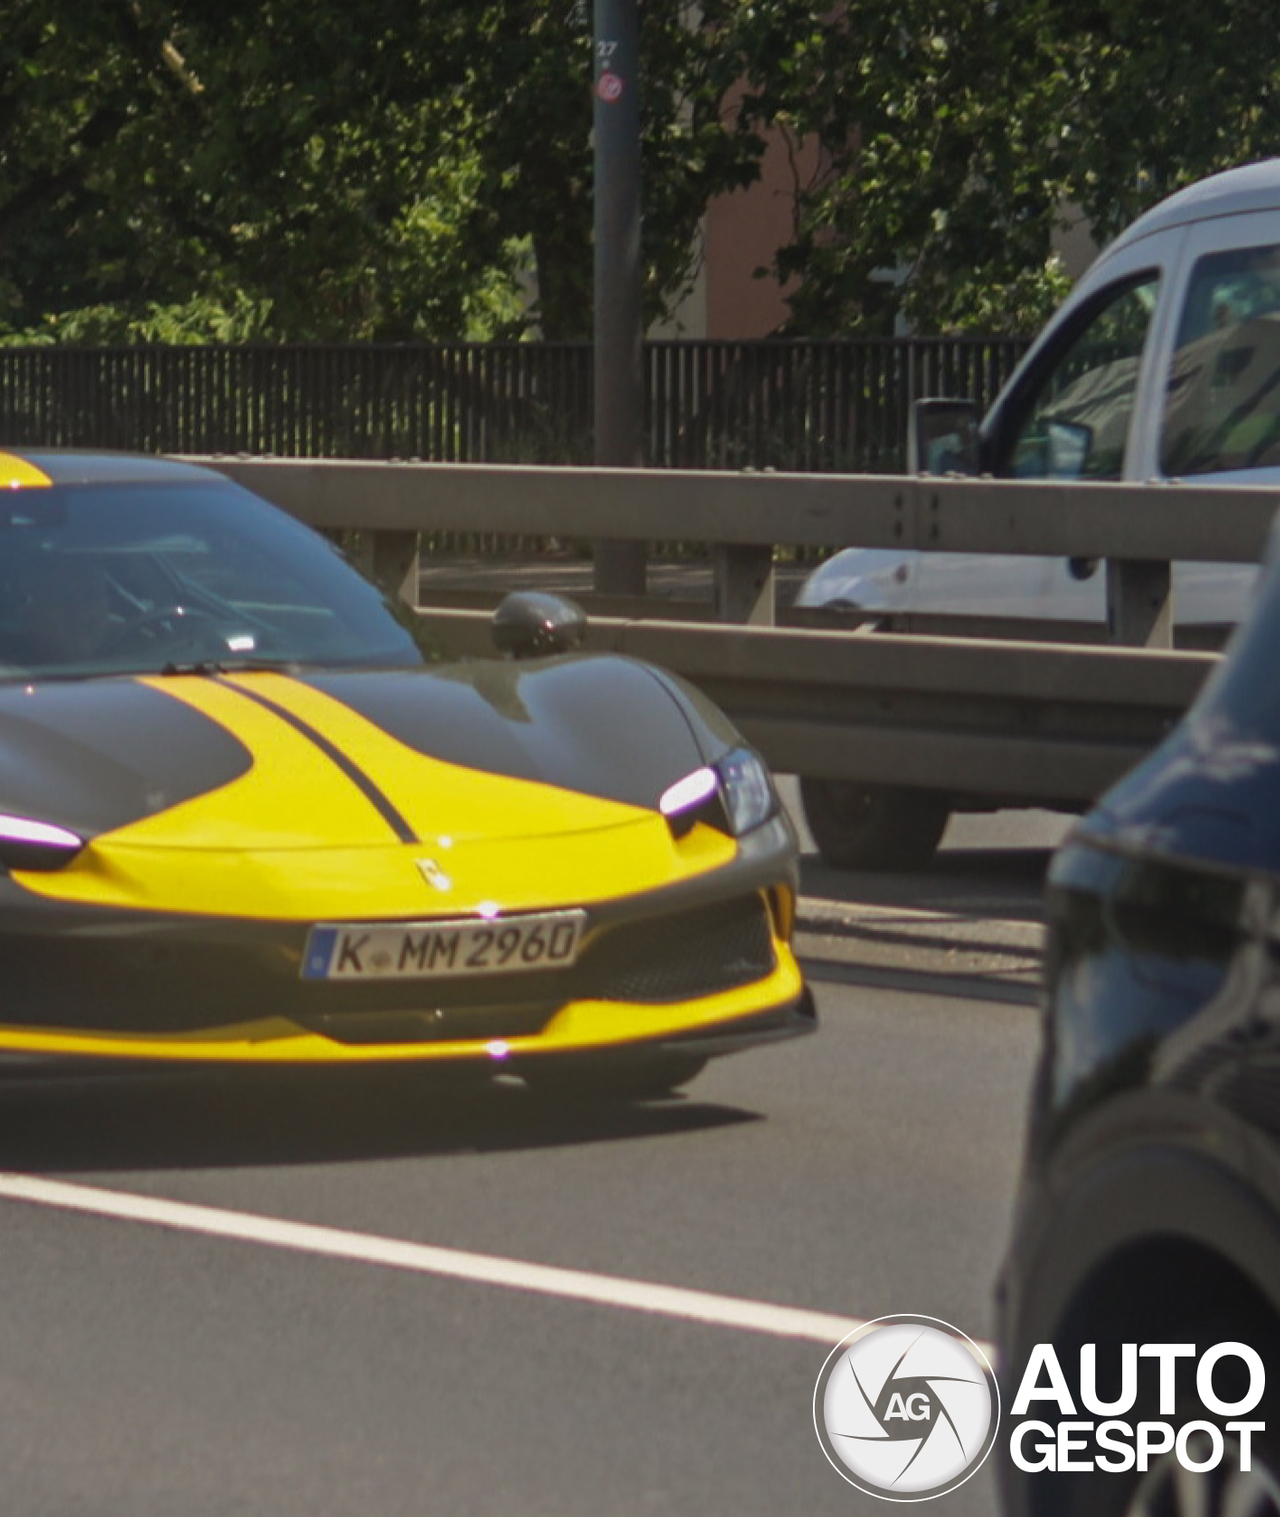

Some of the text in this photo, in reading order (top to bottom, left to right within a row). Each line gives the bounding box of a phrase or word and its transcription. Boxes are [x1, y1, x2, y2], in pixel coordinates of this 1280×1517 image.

[337, 921, 576, 973] K MM 2960
